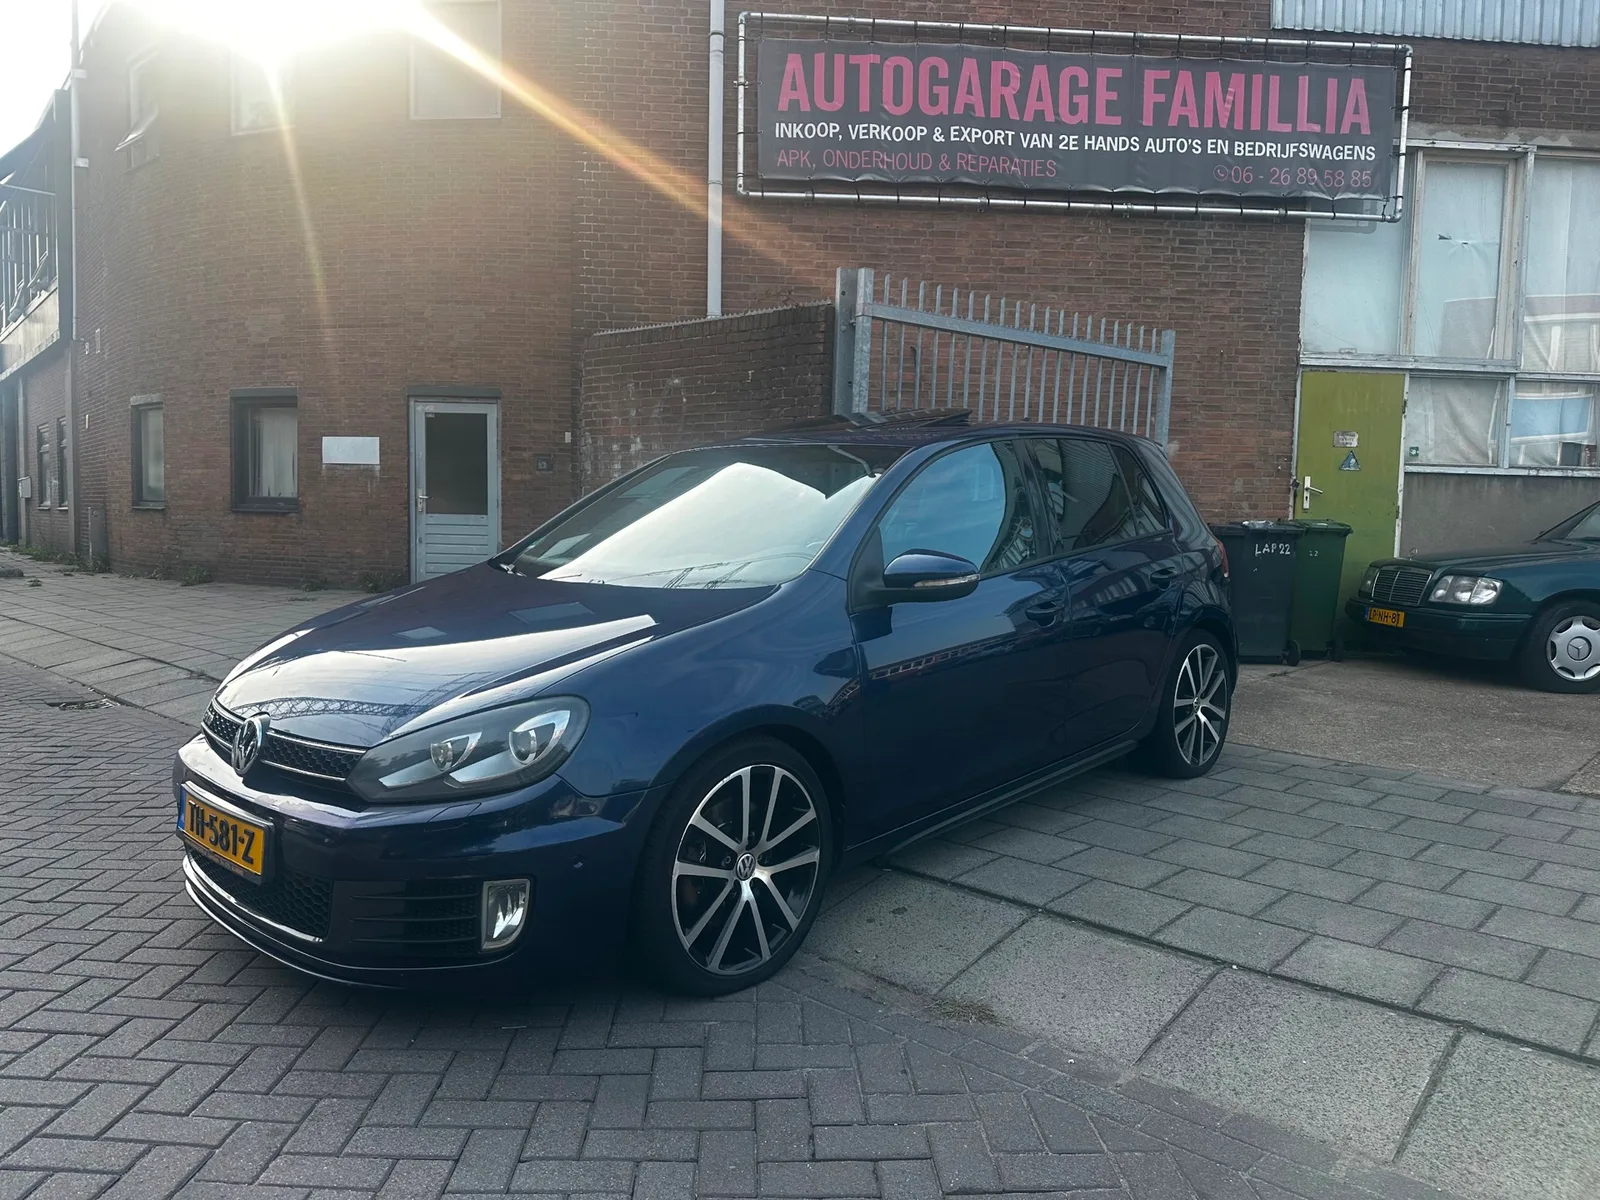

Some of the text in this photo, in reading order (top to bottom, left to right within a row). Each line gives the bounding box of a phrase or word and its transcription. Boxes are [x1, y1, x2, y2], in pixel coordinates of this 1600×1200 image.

[777, 52, 1371, 135] AUTOGARAGE FAMILLIA
[775, 122, 1376, 161] INKOOP, VERKOOP & EXPORT VAN 2E HANDS AUTO'S EN BEDRIJFSWAGENS
[777, 149, 1057, 178] APK, ONDERHOUD & REPARATIES
[1231, 166, 1253, 184] 06
[1269, 167, 1291, 185] 26
[1297, 168, 1318, 186] 89
[1323, 170, 1345, 187] 58
[1350, 170, 1372, 188] 85
[188, 800, 256, 865] TH-581-Z
